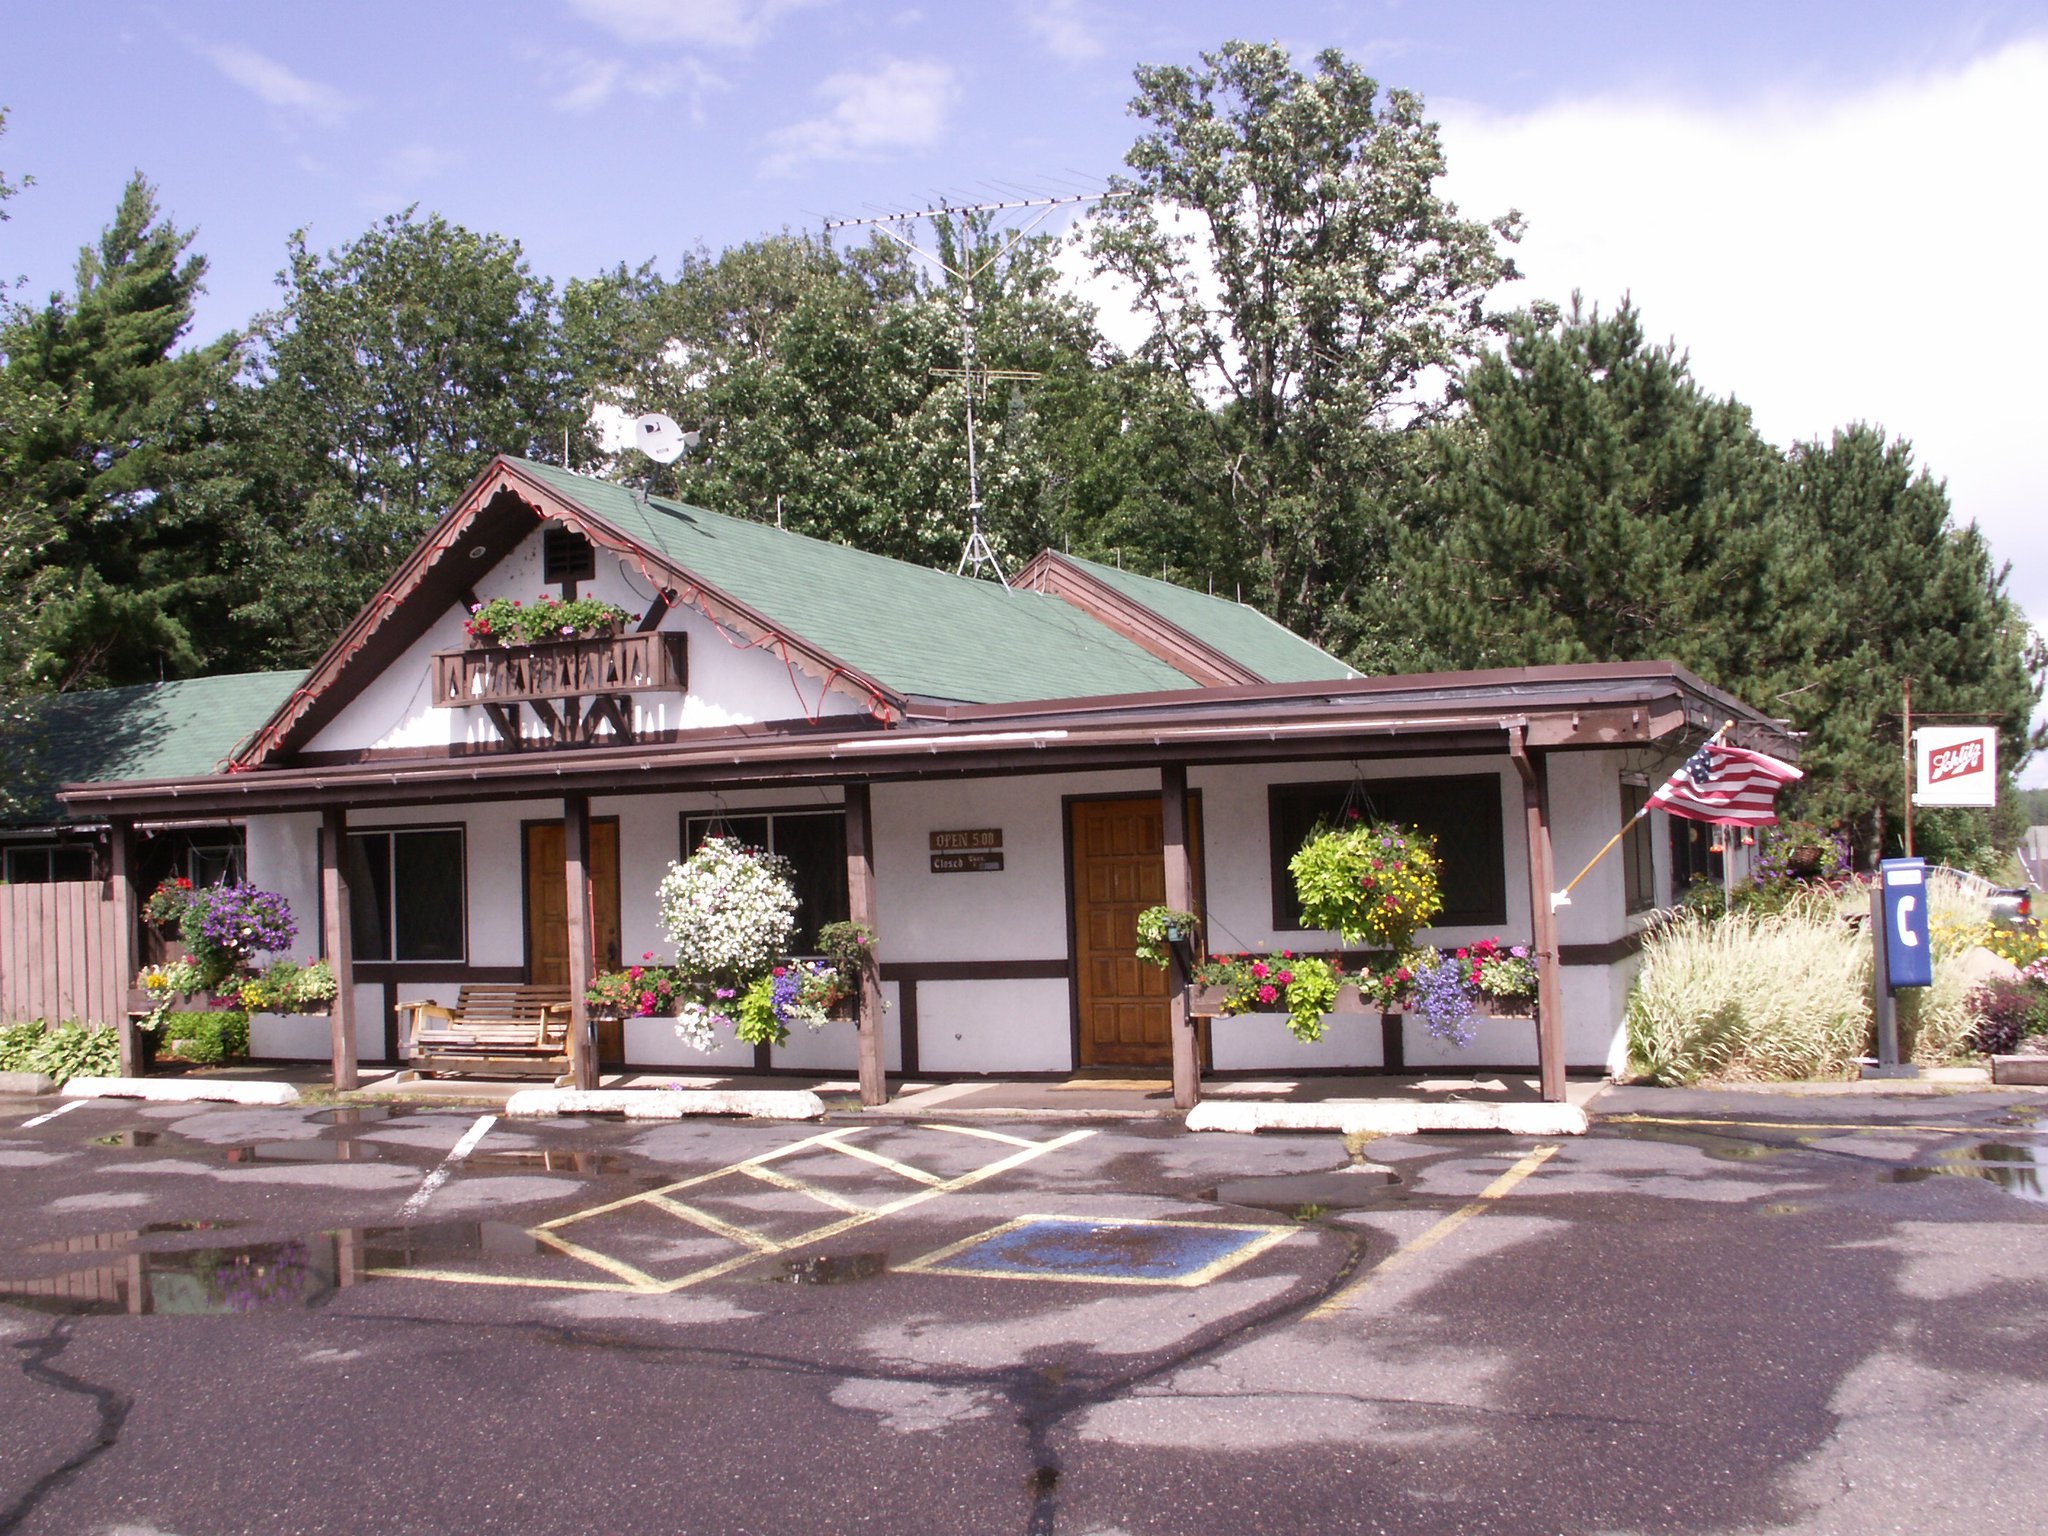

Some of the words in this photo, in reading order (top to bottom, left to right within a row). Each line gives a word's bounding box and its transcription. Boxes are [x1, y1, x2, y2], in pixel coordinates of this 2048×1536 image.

[1932, 743, 1982, 779] Schlitz
[937, 833, 968, 848] OPEN
[934, 858, 963, 869] Closed
